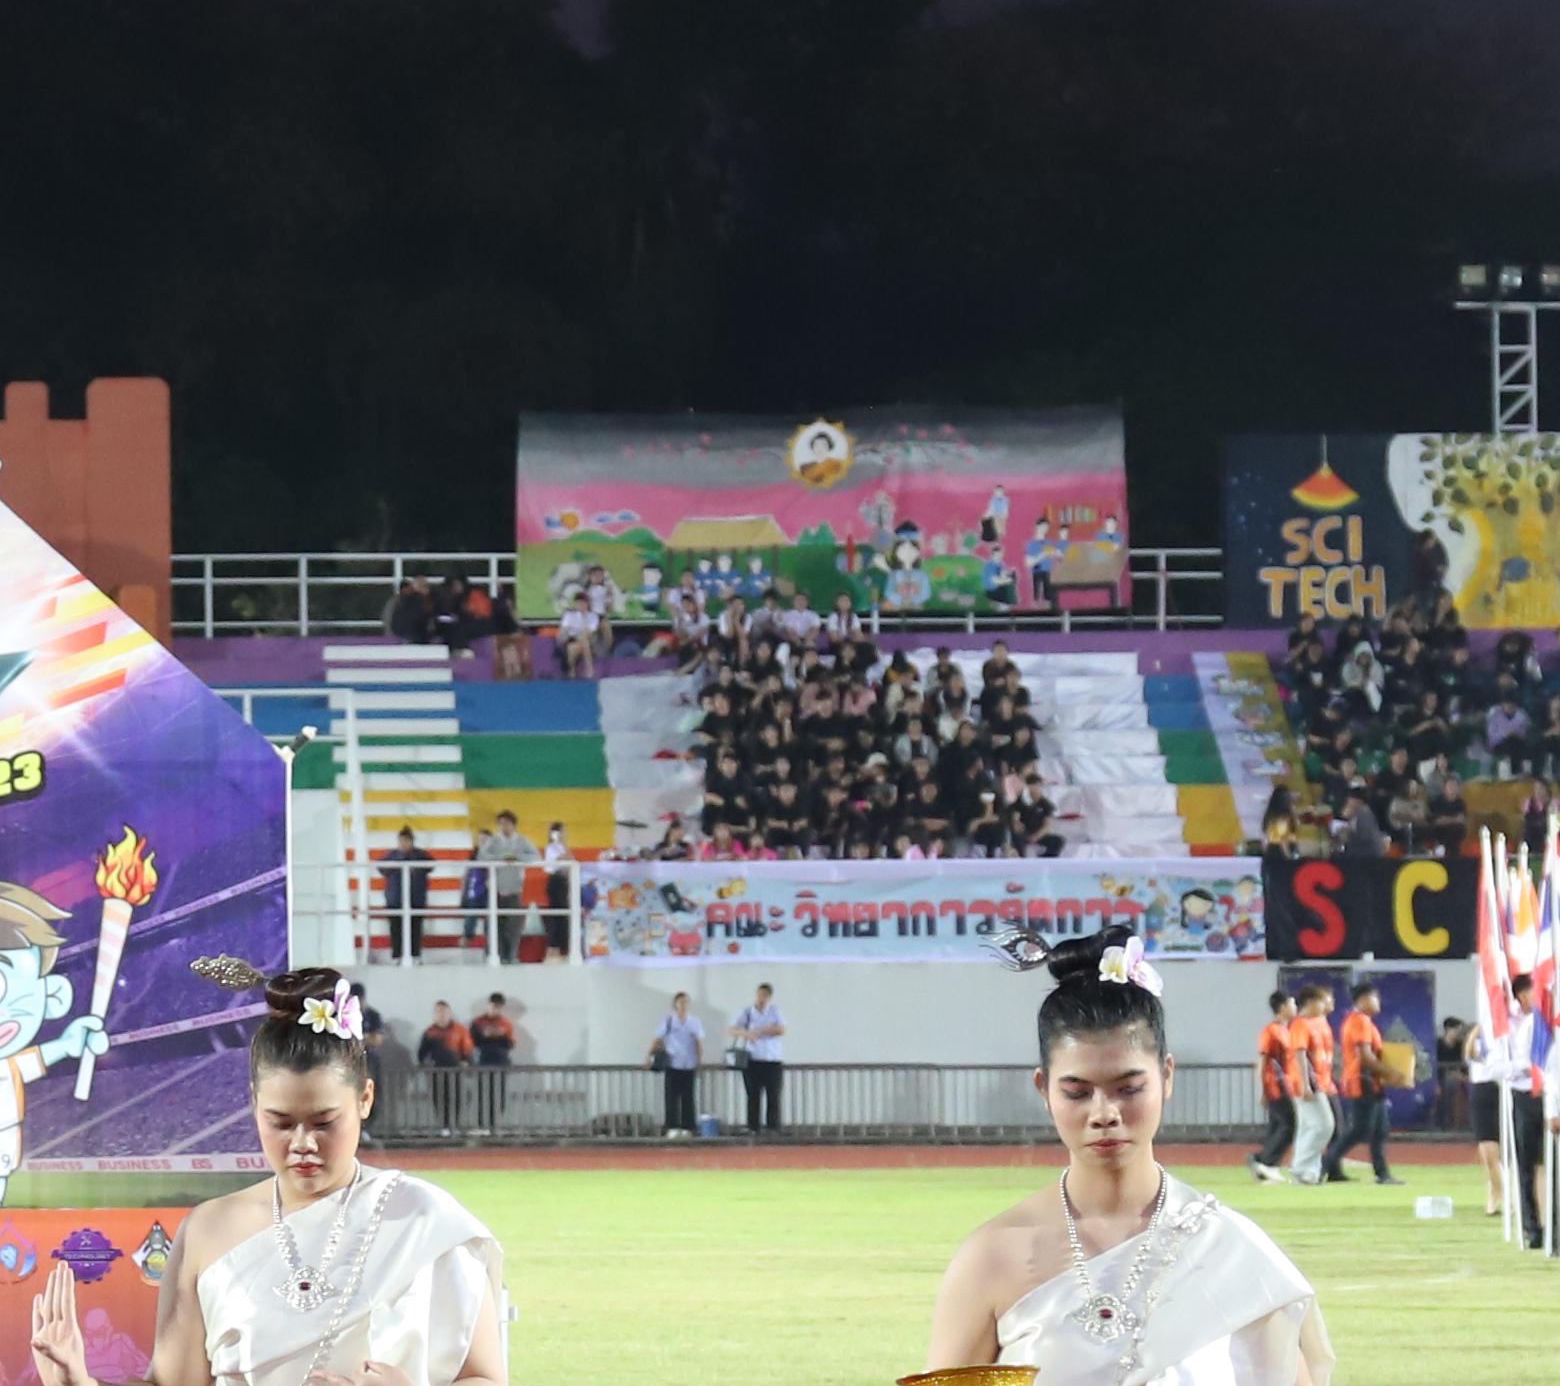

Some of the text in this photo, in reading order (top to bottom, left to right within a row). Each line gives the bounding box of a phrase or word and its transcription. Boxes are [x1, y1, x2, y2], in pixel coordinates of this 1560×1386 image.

[1282, 515, 1363, 565] SCI
[1259, 565, 1387, 619] TECH
[97, 1159, 172, 1170] BUSINESS
